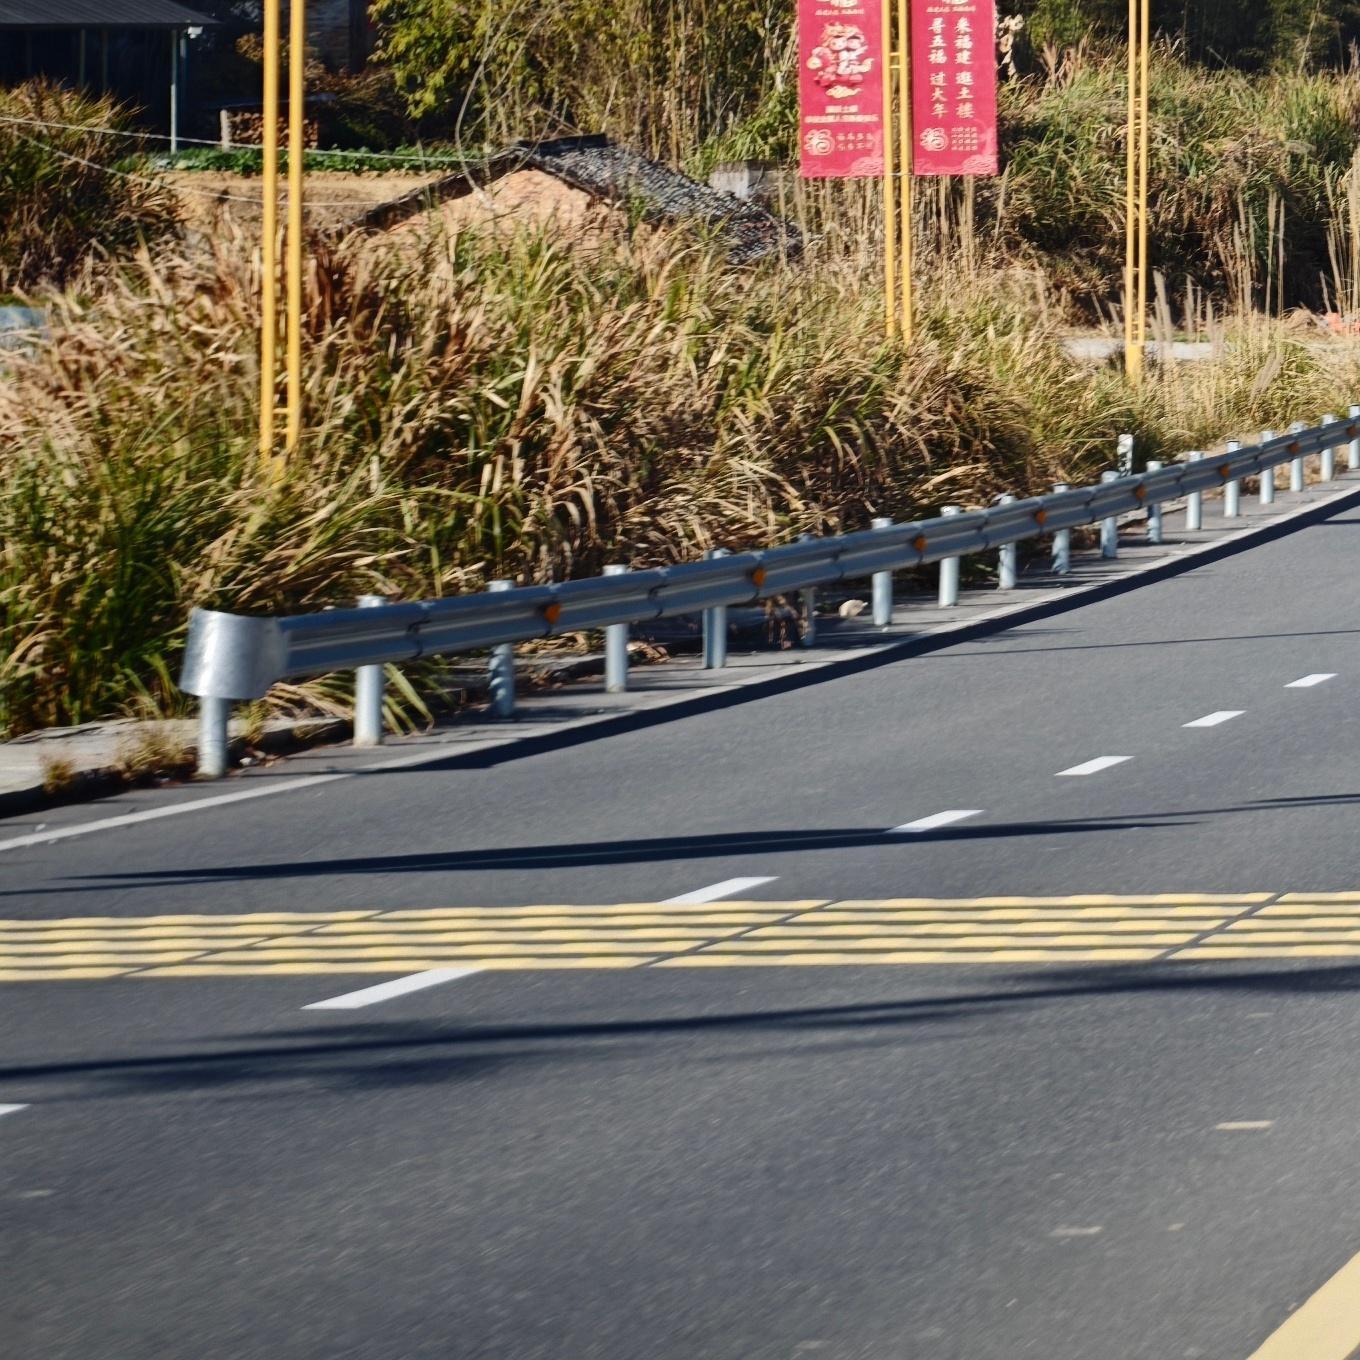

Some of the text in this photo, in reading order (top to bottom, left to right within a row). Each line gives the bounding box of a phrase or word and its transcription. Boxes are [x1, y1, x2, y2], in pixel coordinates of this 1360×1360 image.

[927, 17, 949, 119] 寻五福 过大年
[953, 17, 974, 65] 来福建
